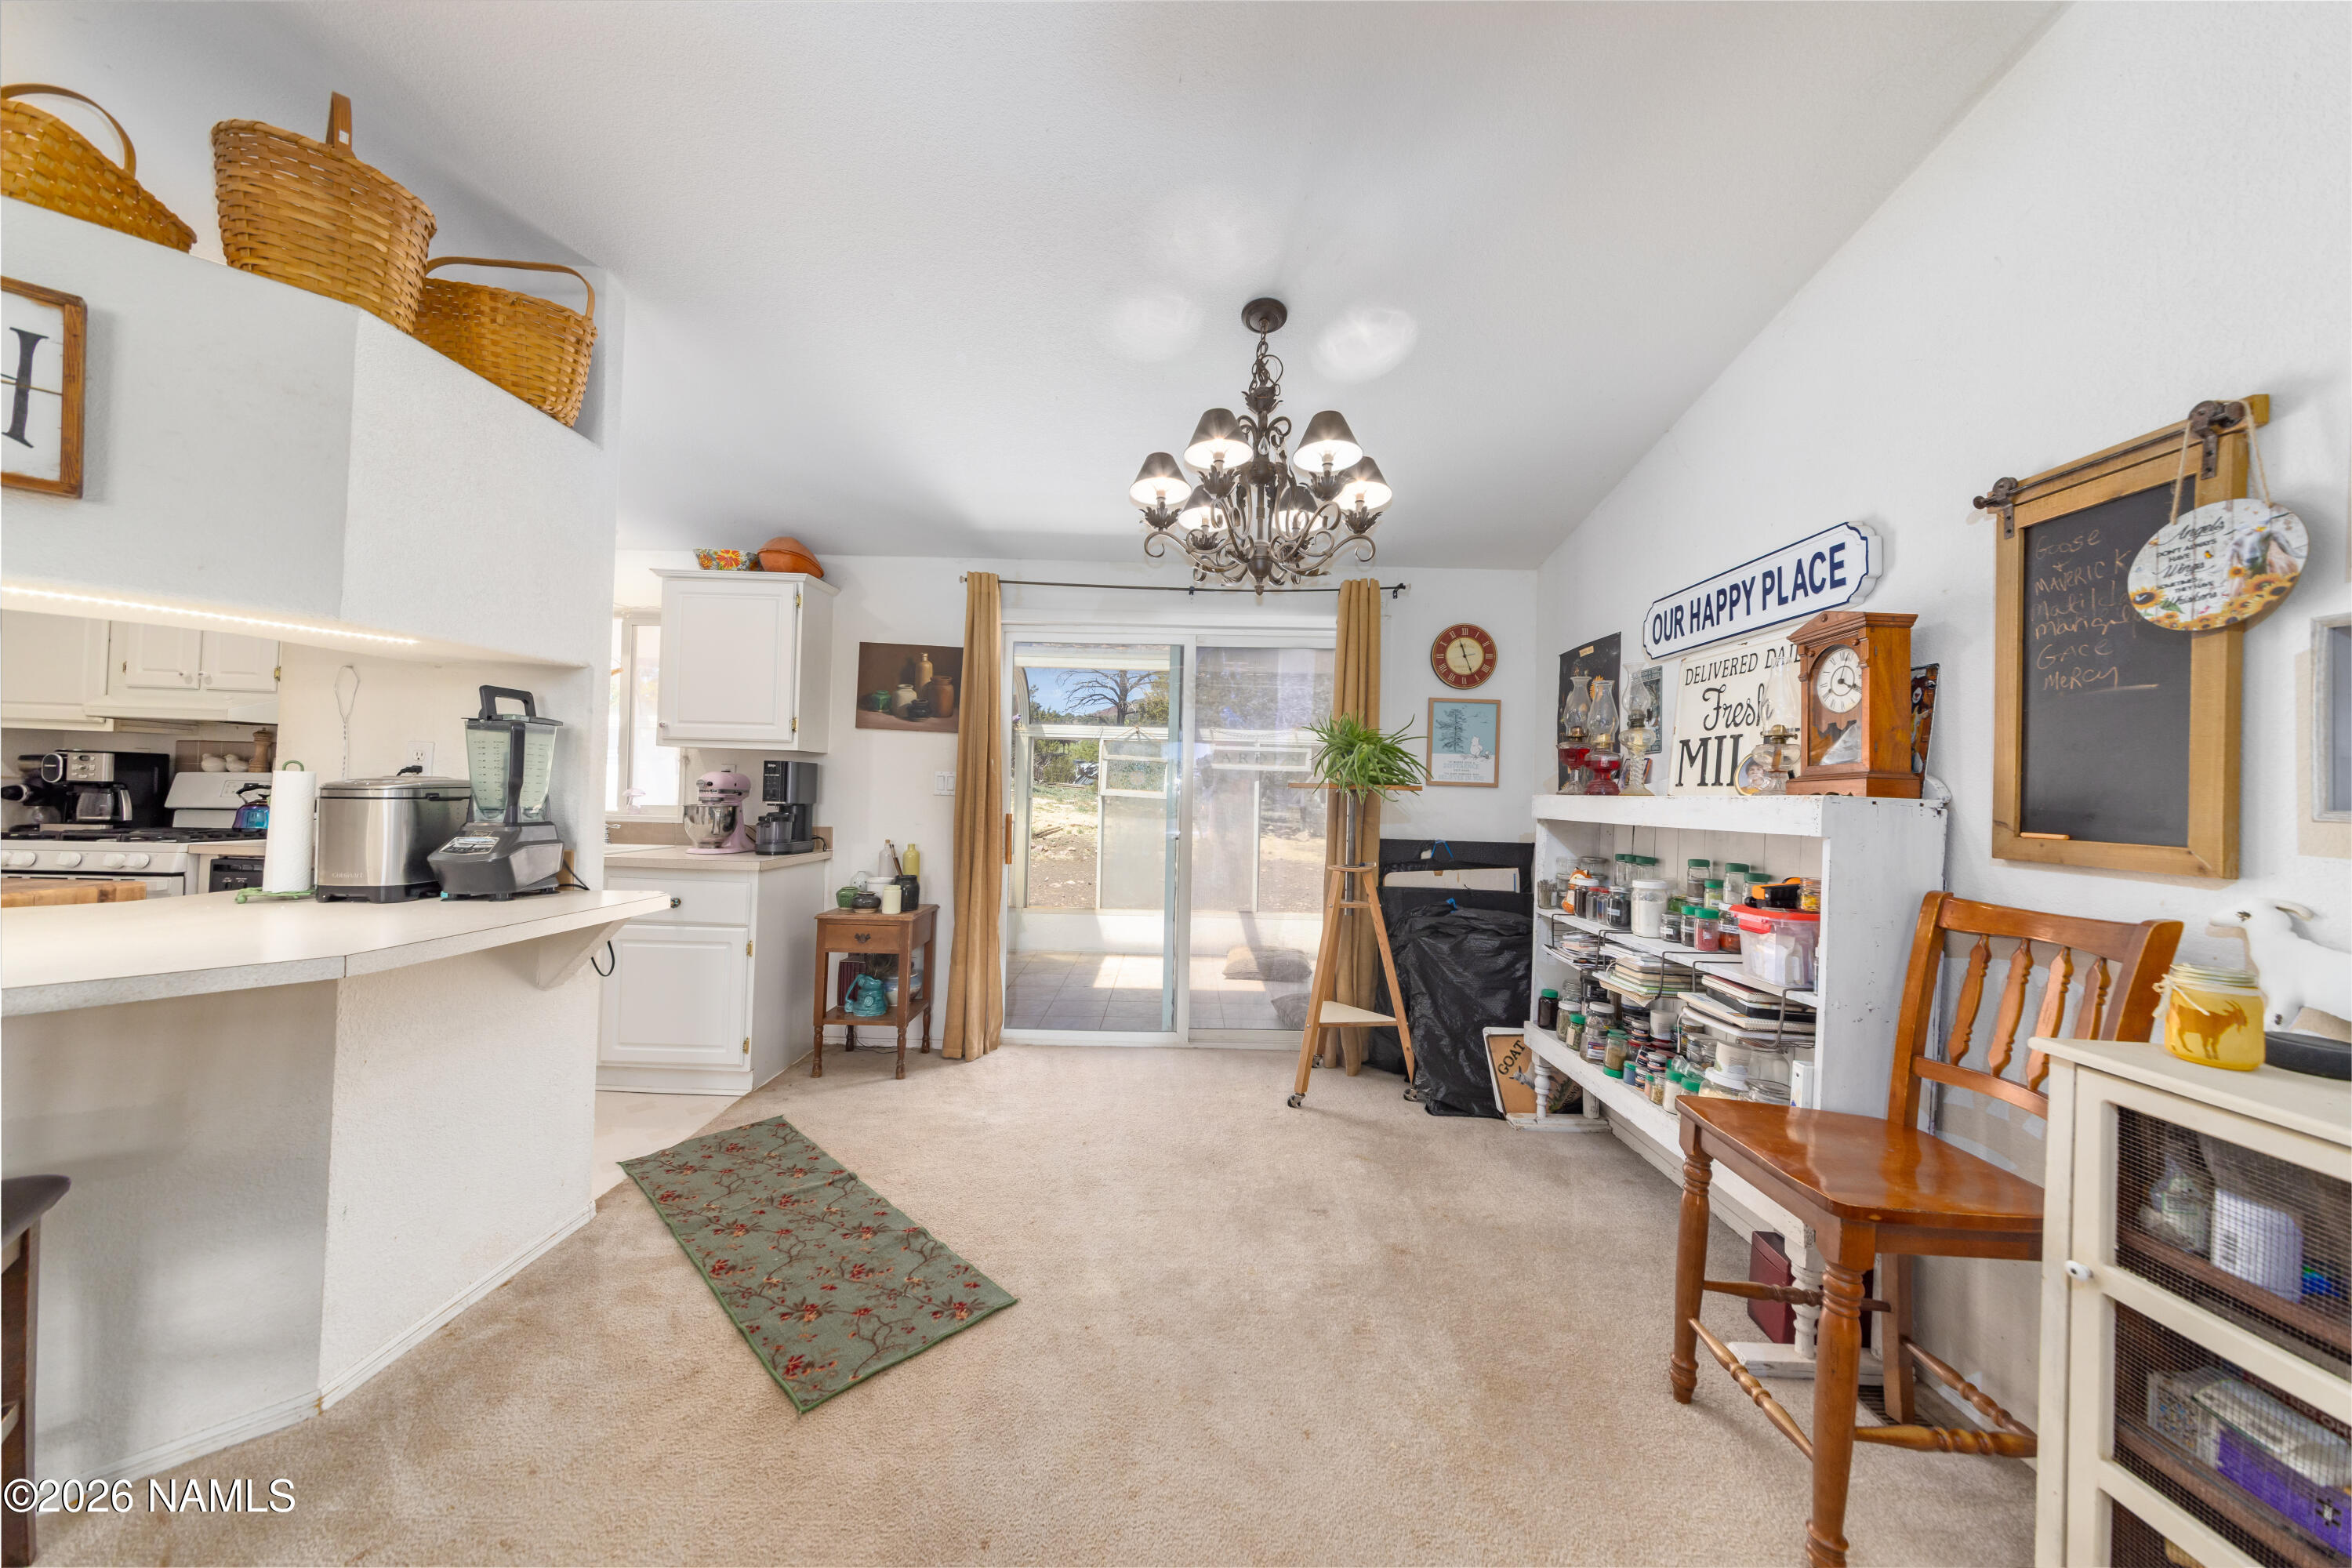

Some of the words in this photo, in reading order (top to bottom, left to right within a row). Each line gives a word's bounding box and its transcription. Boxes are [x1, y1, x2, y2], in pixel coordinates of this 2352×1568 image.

[2035, 529, 2101, 560] Goose
[1652, 604, 1685, 645] OUR
[1690, 576, 1756, 633] HAPPY
[1762, 542, 1846, 611] PLACE
[1685, 652, 1758, 686] DELIVERED
[1764, 644, 1801, 669] DAIL
[1702, 684, 1774, 731] Fresh
[1498, 1040, 1526, 1075] GOAT
